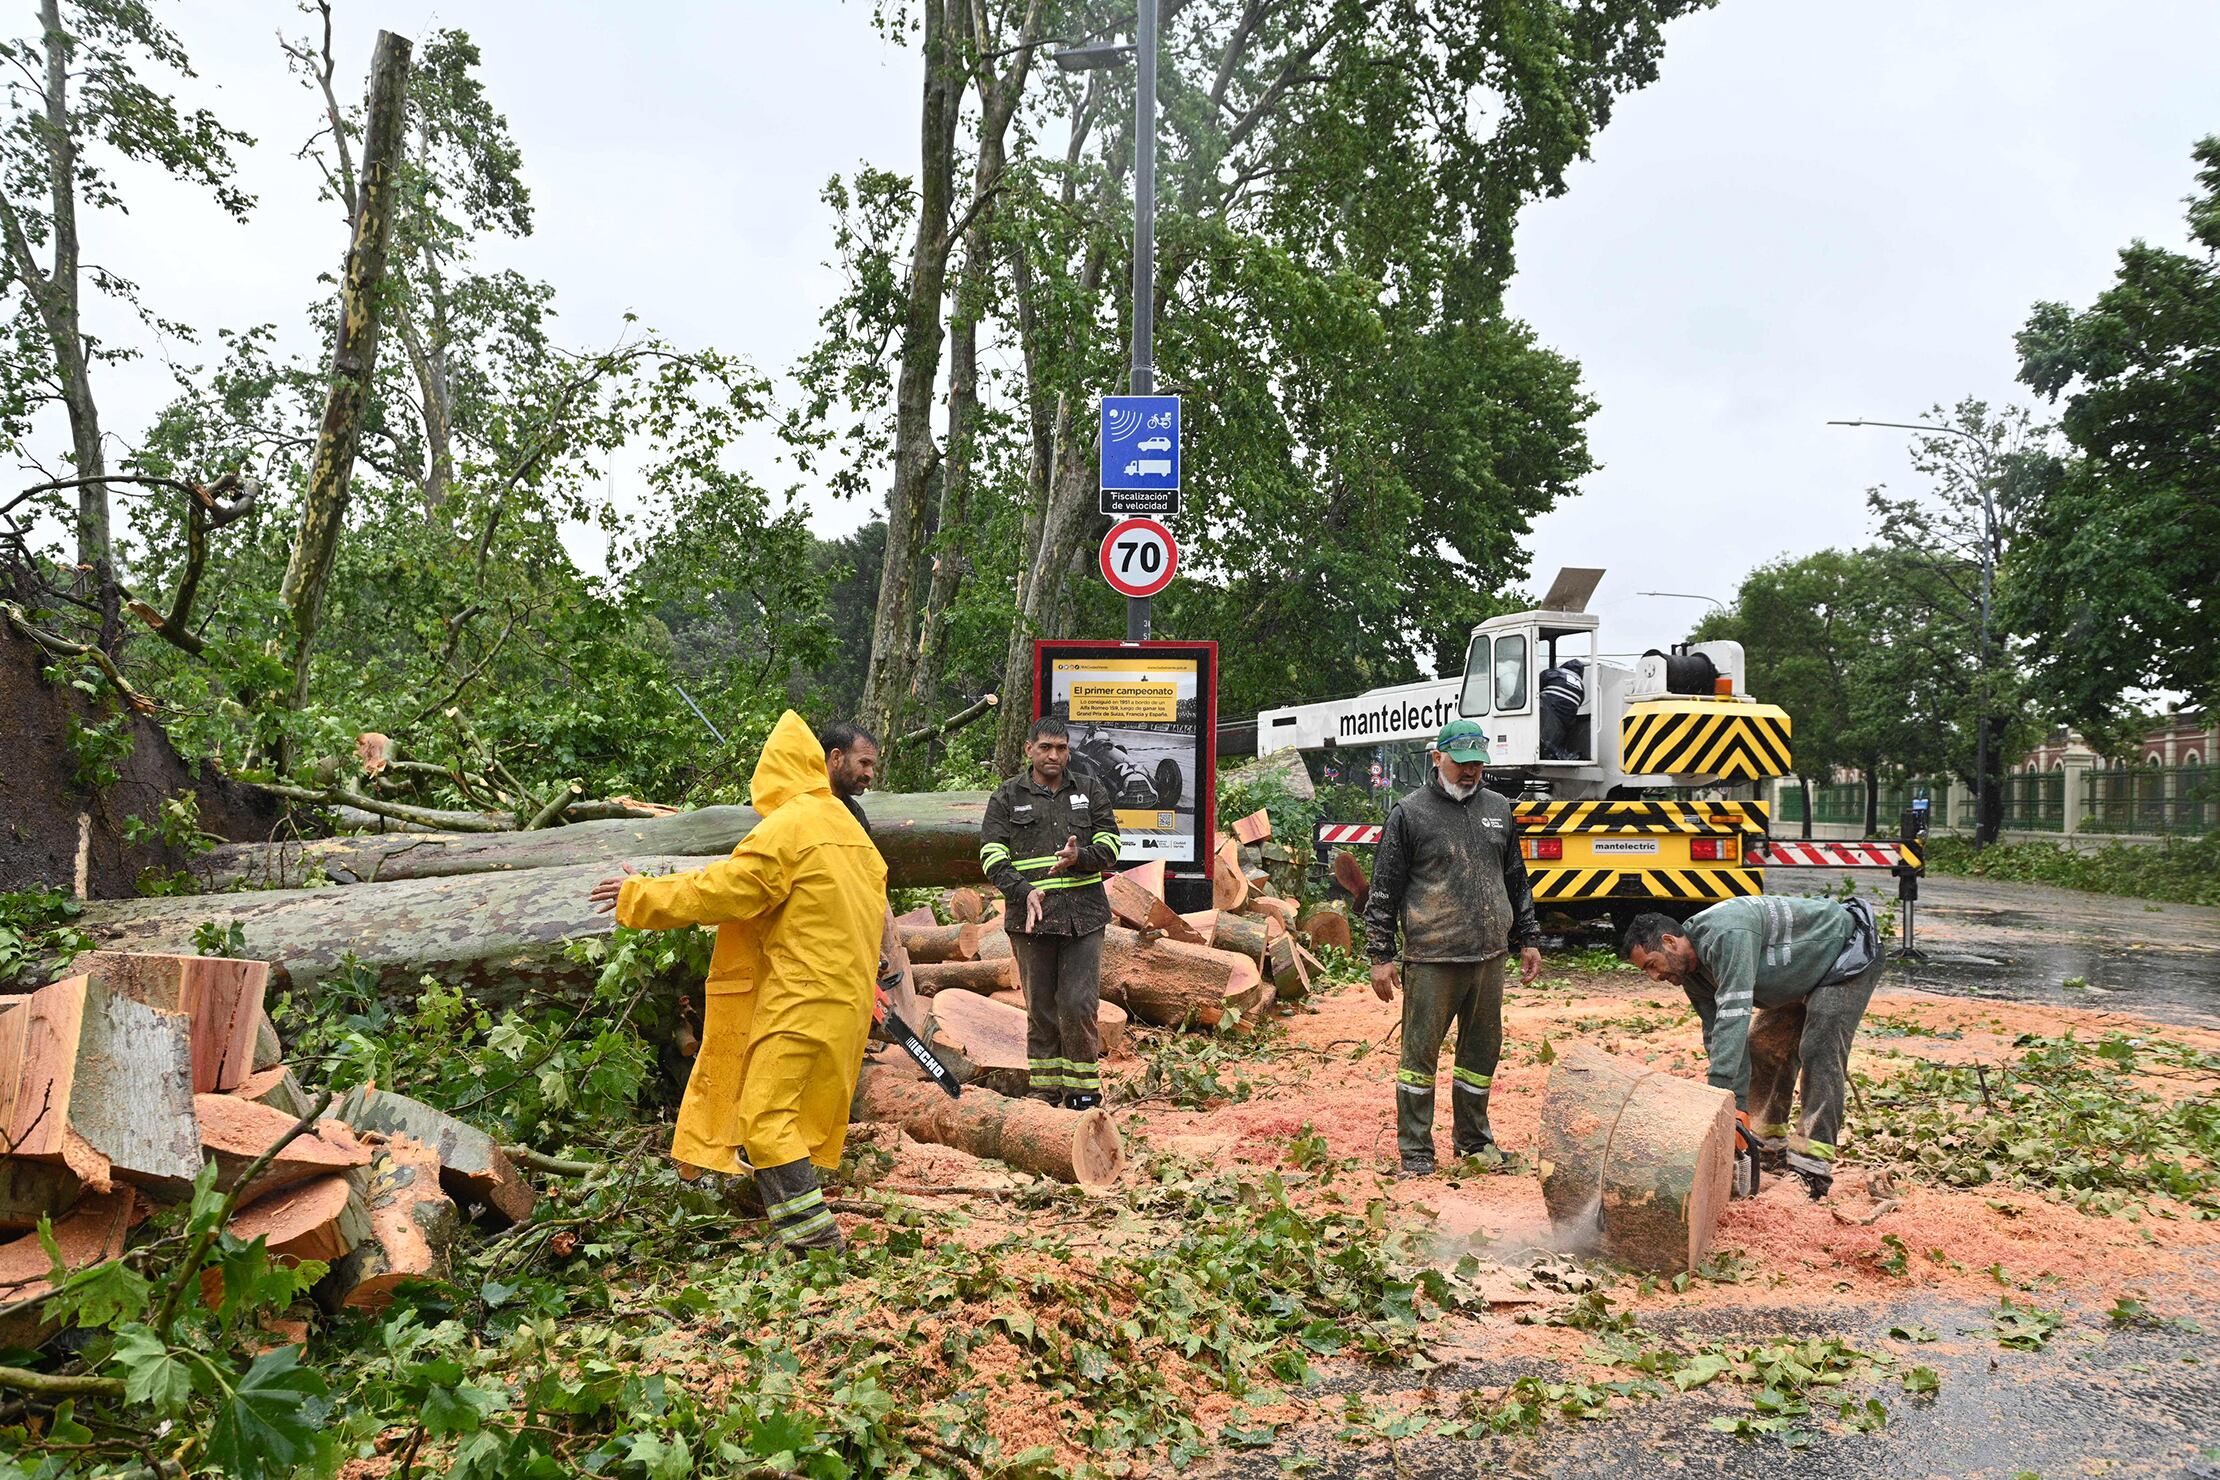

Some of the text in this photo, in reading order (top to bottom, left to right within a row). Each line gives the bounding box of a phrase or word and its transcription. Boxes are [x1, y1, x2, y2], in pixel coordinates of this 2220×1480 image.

[1112, 492, 1168, 501] Fiscalización
[1112, 502, 1168, 510] de velocidad
[1117, 541, 1161, 573] 70
[1074, 686, 1173, 696] El primer campeonato
[1340, 694, 1459, 736] mantelectri
[1142, 839, 1158, 848] BA
[913, 1044, 945, 1078] ECHO
